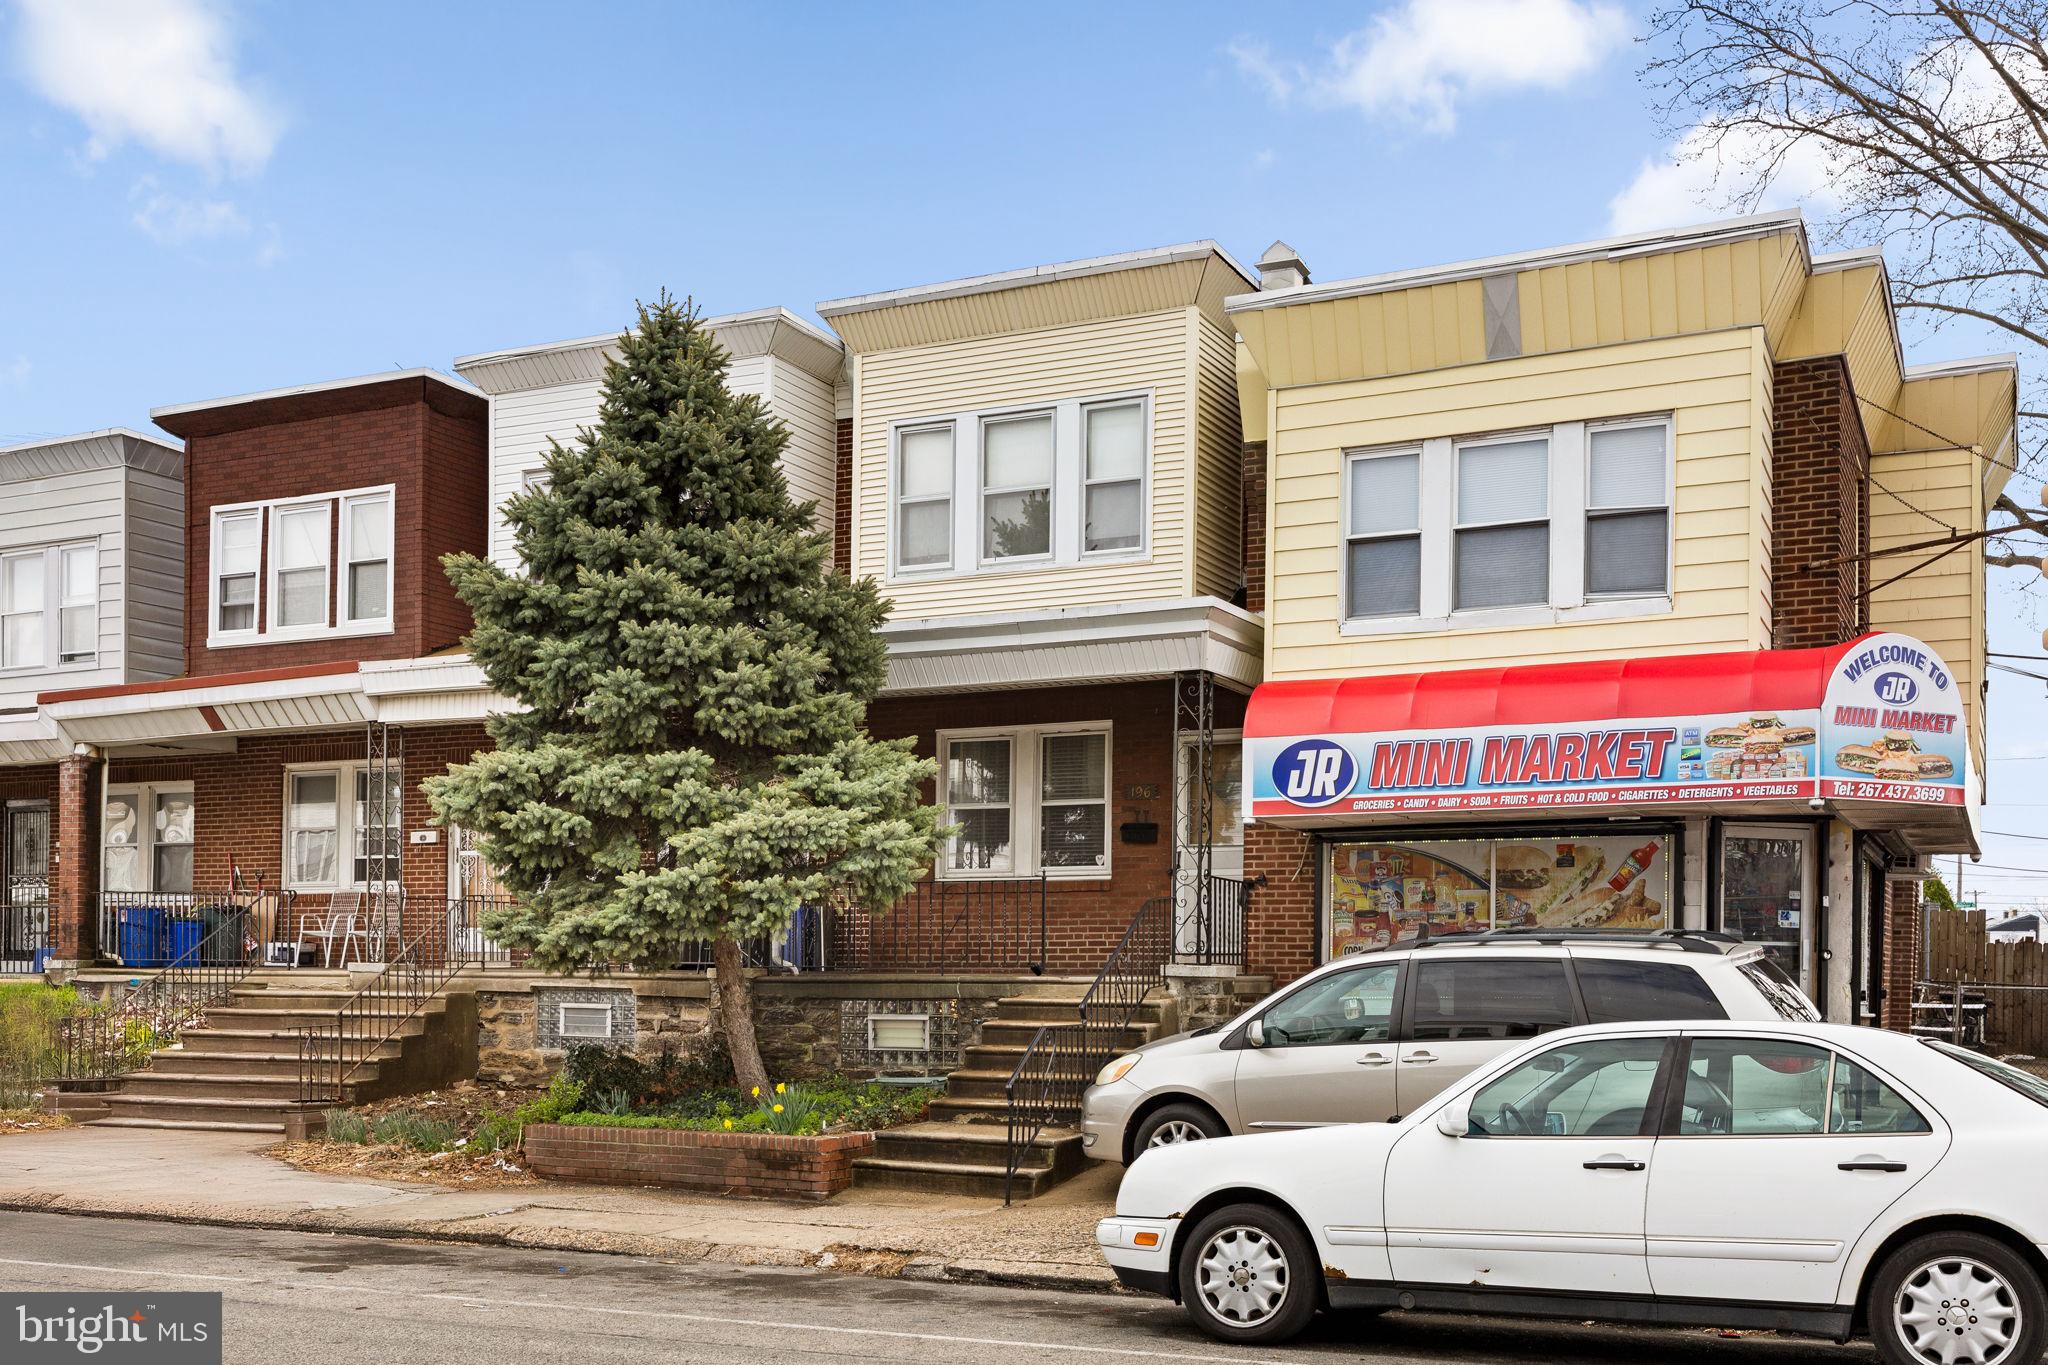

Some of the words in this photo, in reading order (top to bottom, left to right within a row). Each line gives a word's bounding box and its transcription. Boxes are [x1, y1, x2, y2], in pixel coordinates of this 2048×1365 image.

[1843, 645, 1927, 683] WELCOME
[1929, 661, 1949, 691] TO
[1882, 676, 1911, 702] JR
[1834, 706, 1878, 728] MINI
[1881, 709, 1957, 734] MARKET
[1287, 748, 1343, 798] JR
[1368, 738, 1472, 790] MINI
[1478, 728, 1677, 785] MARKET
[1353, 800, 1395, 810] GROCERIES
[1403, 798, 1430, 808] CANDY
[1437, 797, 1462, 808] DAIRY
[1469, 796, 1491, 806] SODA
[1500, 794, 1528, 805] FRUITS
[1537, 793, 1553, 804] HOT
[1555, 793, 1562, 803] &
[1563, 792, 1585, 803] COLD
[1586, 791, 1609, 802] FOOD
[1618, 789, 1669, 801] CIGARETTES
[1678, 786, 1734, 799] DETERGENTS
[1743, 784, 1798, 797] VEGETABLES
[1833, 781, 1854, 797] Tel:
[1857, 782, 1945, 802] 267.437.3699
